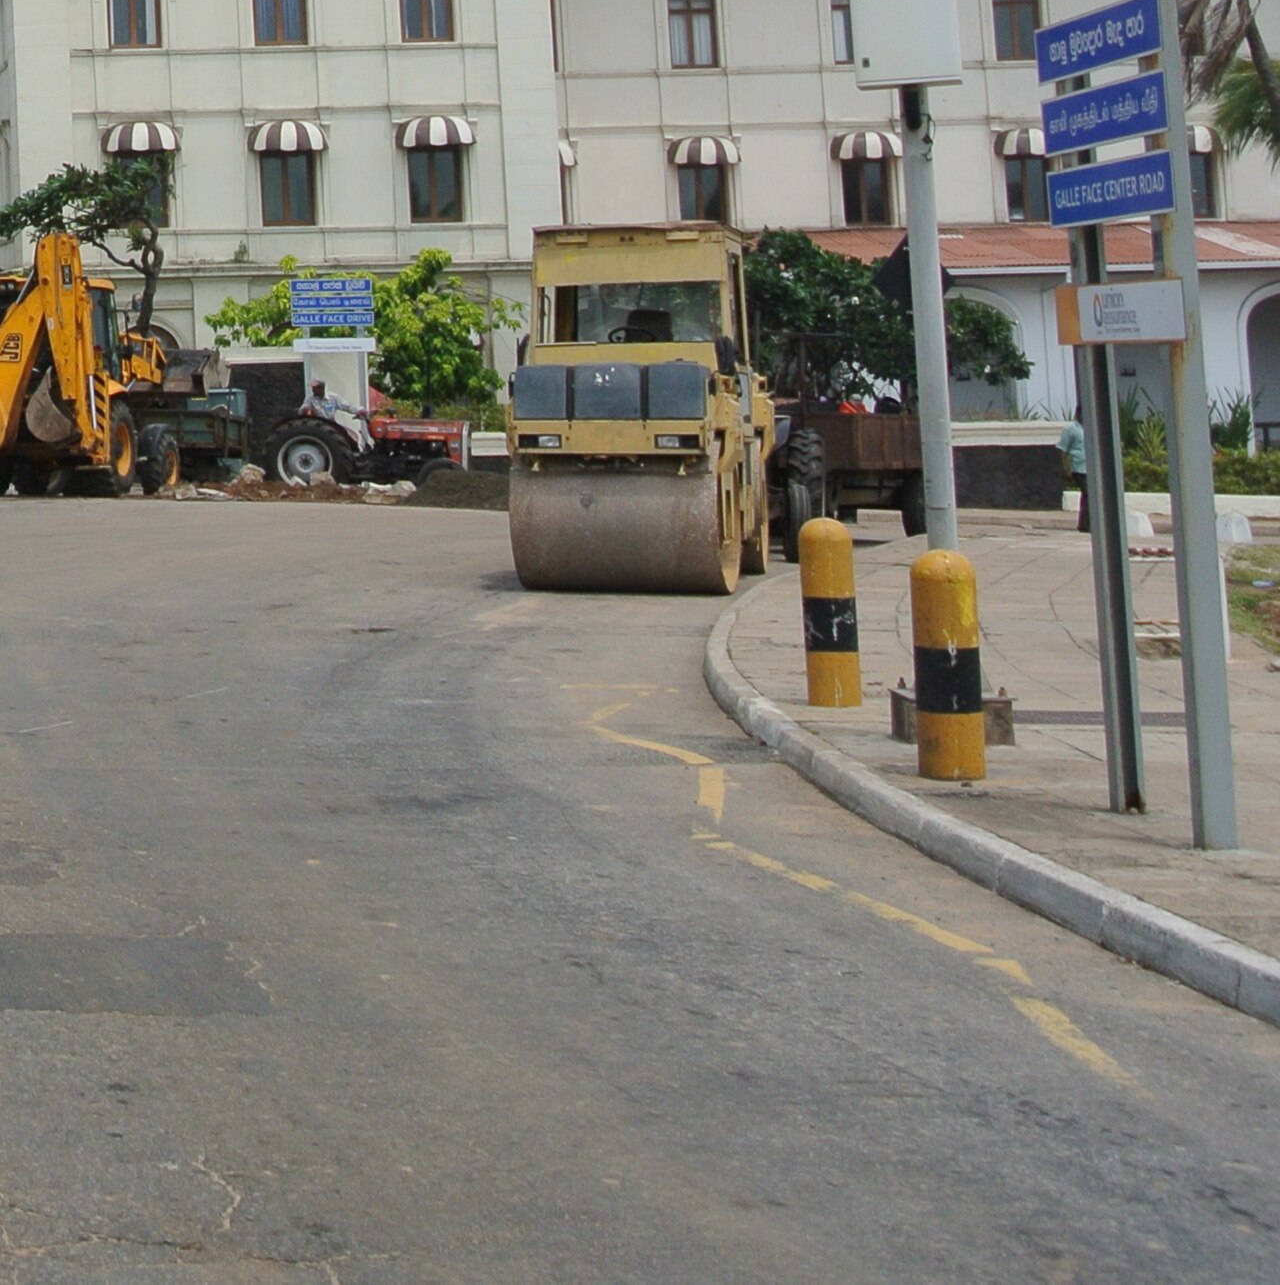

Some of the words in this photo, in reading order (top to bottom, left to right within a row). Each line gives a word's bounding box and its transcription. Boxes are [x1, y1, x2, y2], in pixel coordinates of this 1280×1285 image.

[1126, 10, 1145, 38] පාර
[1055, 186, 1080, 209] GALLE
[1081, 182, 1102, 204] FACE
[1103, 176, 1138, 201] CENTER
[1139, 171, 1165, 196] ROAD
[1102, 292, 1124, 308] union
[294, 315, 320, 323] GALLE
[323, 315, 344, 323] FACE
[347, 314, 372, 322] DRIVE
[0, 336, 20, 360] JCB
